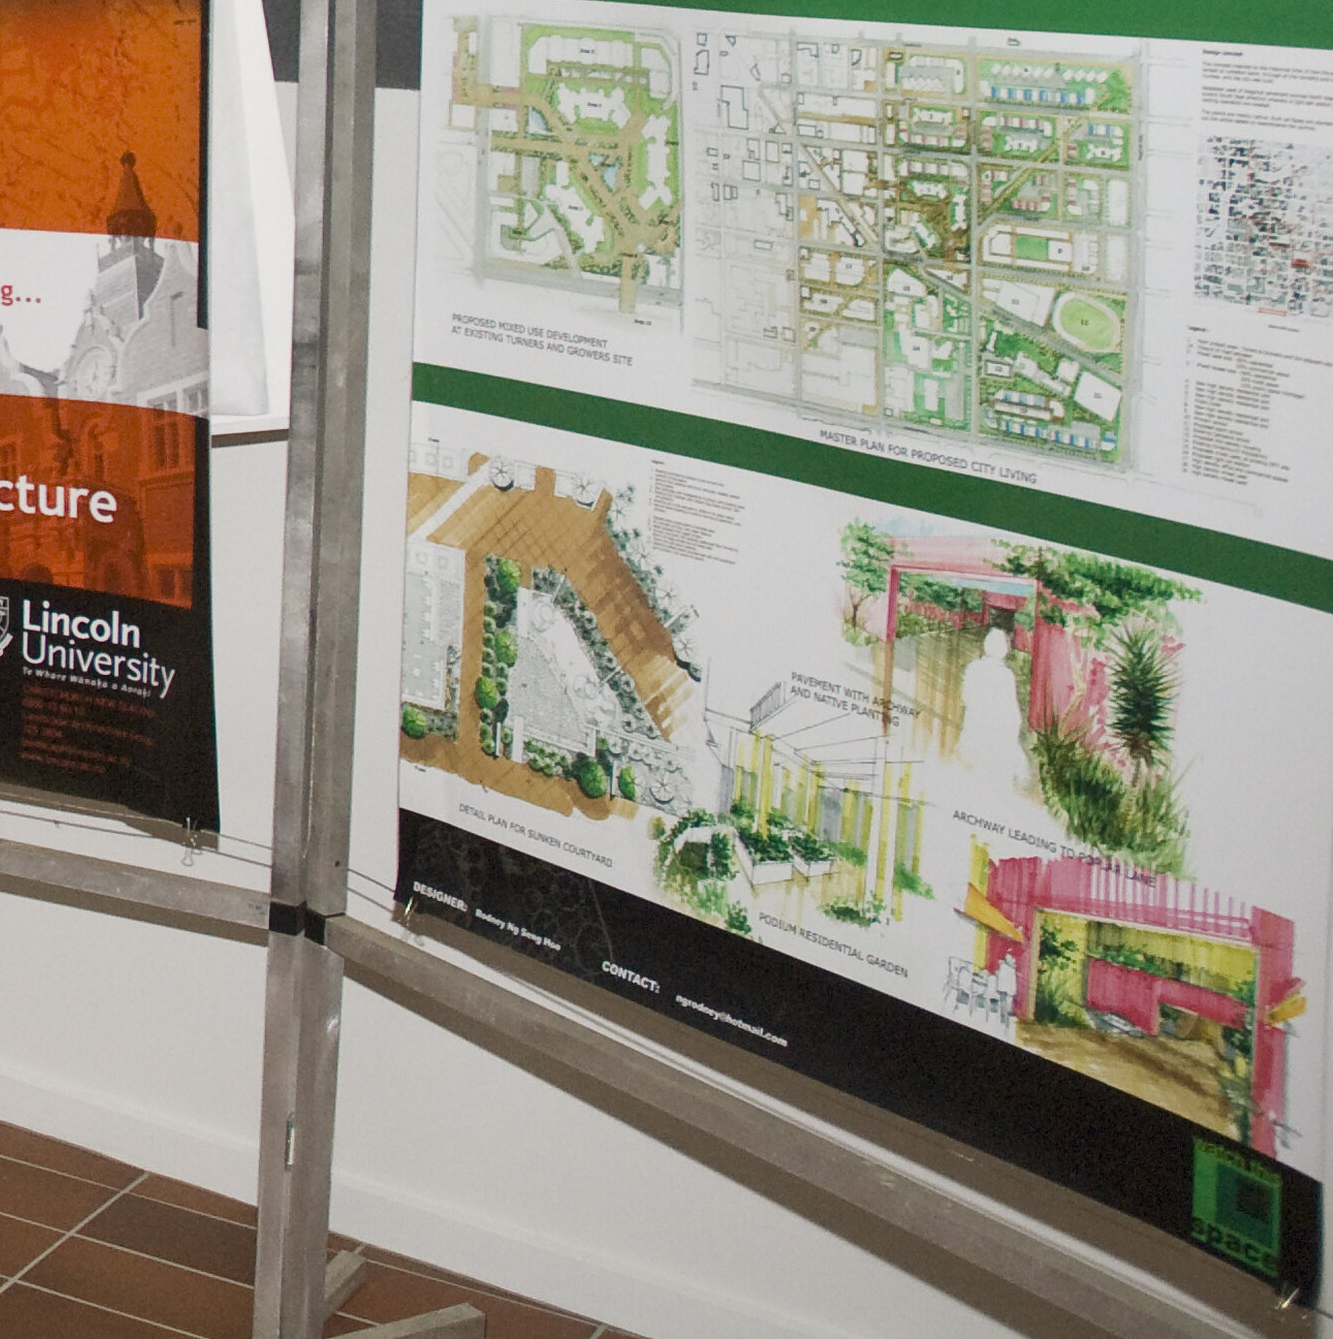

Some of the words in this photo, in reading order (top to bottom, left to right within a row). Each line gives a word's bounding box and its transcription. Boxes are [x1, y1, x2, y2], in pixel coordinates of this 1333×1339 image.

[453, 314, 496, 328] PROPOSED
[499, 322, 525, 333] MIXED
[527, 327, 543, 337] USE
[547, 330, 608, 348] DEVELOPMENT
[465, 328, 503, 342] EXISTING
[506, 335, 544, 350] TURNERS
[547, 342, 564, 353] AND
[568, 346, 610, 362] GROWERS
[820, 430, 857, 446] MASTER
[861, 439, 884, 452] PLAN
[889, 444, 908, 456] FOR
[912, 450, 967, 469] PROPOSED
[971, 461, 997, 473] CITY
[1000, 468, 1037, 484] LIVING
[23, 599, 140, 648] Lincoln
[23, 631, 175, 699] University
[35, 669, 66, 681] Whare
[792, 672, 842, 694] PAVEMENT
[844, 687, 870, 701] WITH
[791, 686, 810, 699] AND
[814, 692, 848, 710] NATIVE
[459, 803, 485, 821] DETAIL
[488, 815, 507, 829] PLAN
[510, 823, 526, 835] FOR
[528, 829, 561, 849] SUNKEN
[564, 842, 612, 868] COURTYARD
[953, 810, 1005, 834] ARCHWAY
[1008, 828, 1057, 853] LEADING
[1060, 845, 1075, 859] TO
[413, 881, 467, 912] DESIGNER:
[475, 909, 505, 930] Rodney
[759, 913, 796, 934] PODIUM
[799, 928, 864, 961] RESIDENTIAL
[866, 954, 908, 978] GARDEN
[602, 961, 660, 994] CONTACT:
